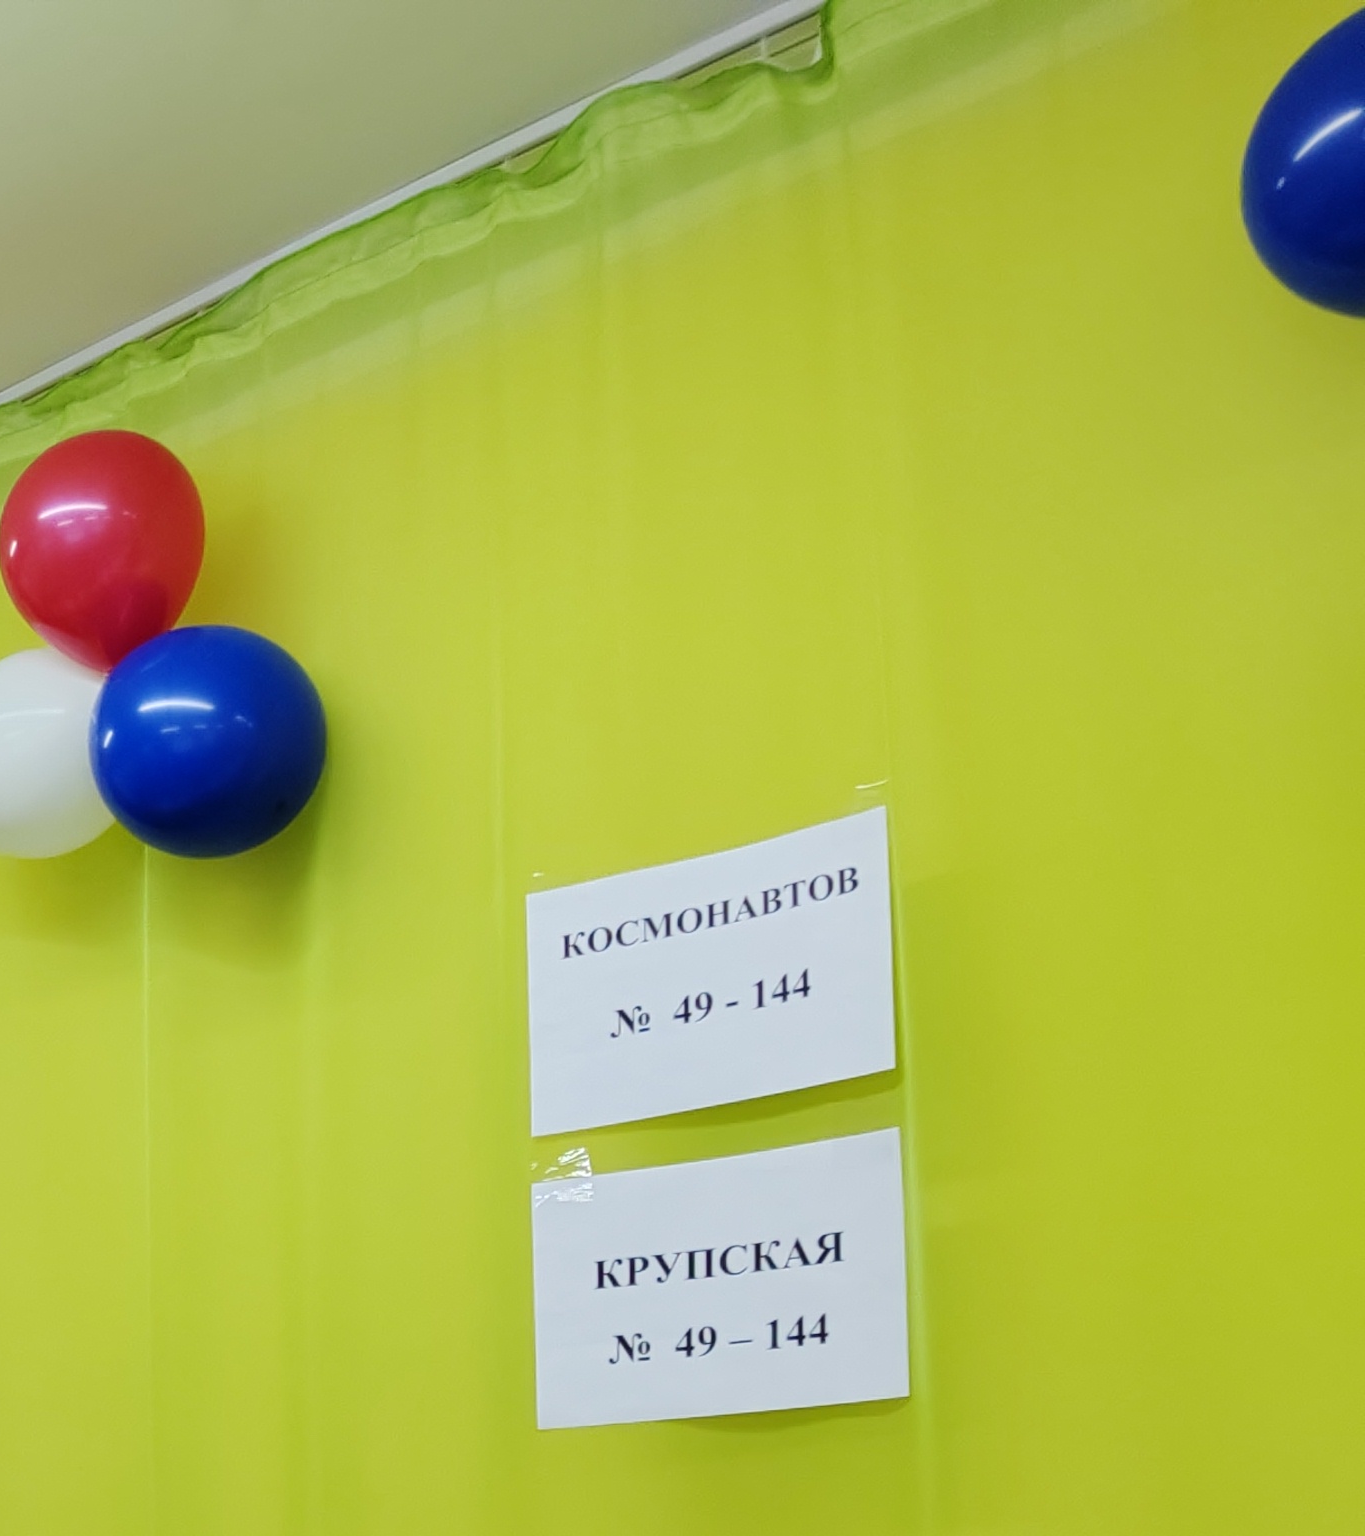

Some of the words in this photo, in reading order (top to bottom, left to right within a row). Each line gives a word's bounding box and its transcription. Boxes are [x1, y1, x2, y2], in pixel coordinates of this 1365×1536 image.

[561, 867, 860, 959] КОСМОНАВТОВ
[610, 1005, 651, 1039] №
[673, 992, 713, 1024] 49
[753, 968, 812, 1009] 144
[594, 1231, 845, 1291] КРУПСКАЯ
[608, 1332, 651, 1366] №
[675, 1326, 717, 1358] 49
[766, 1313, 830, 1351] 144
